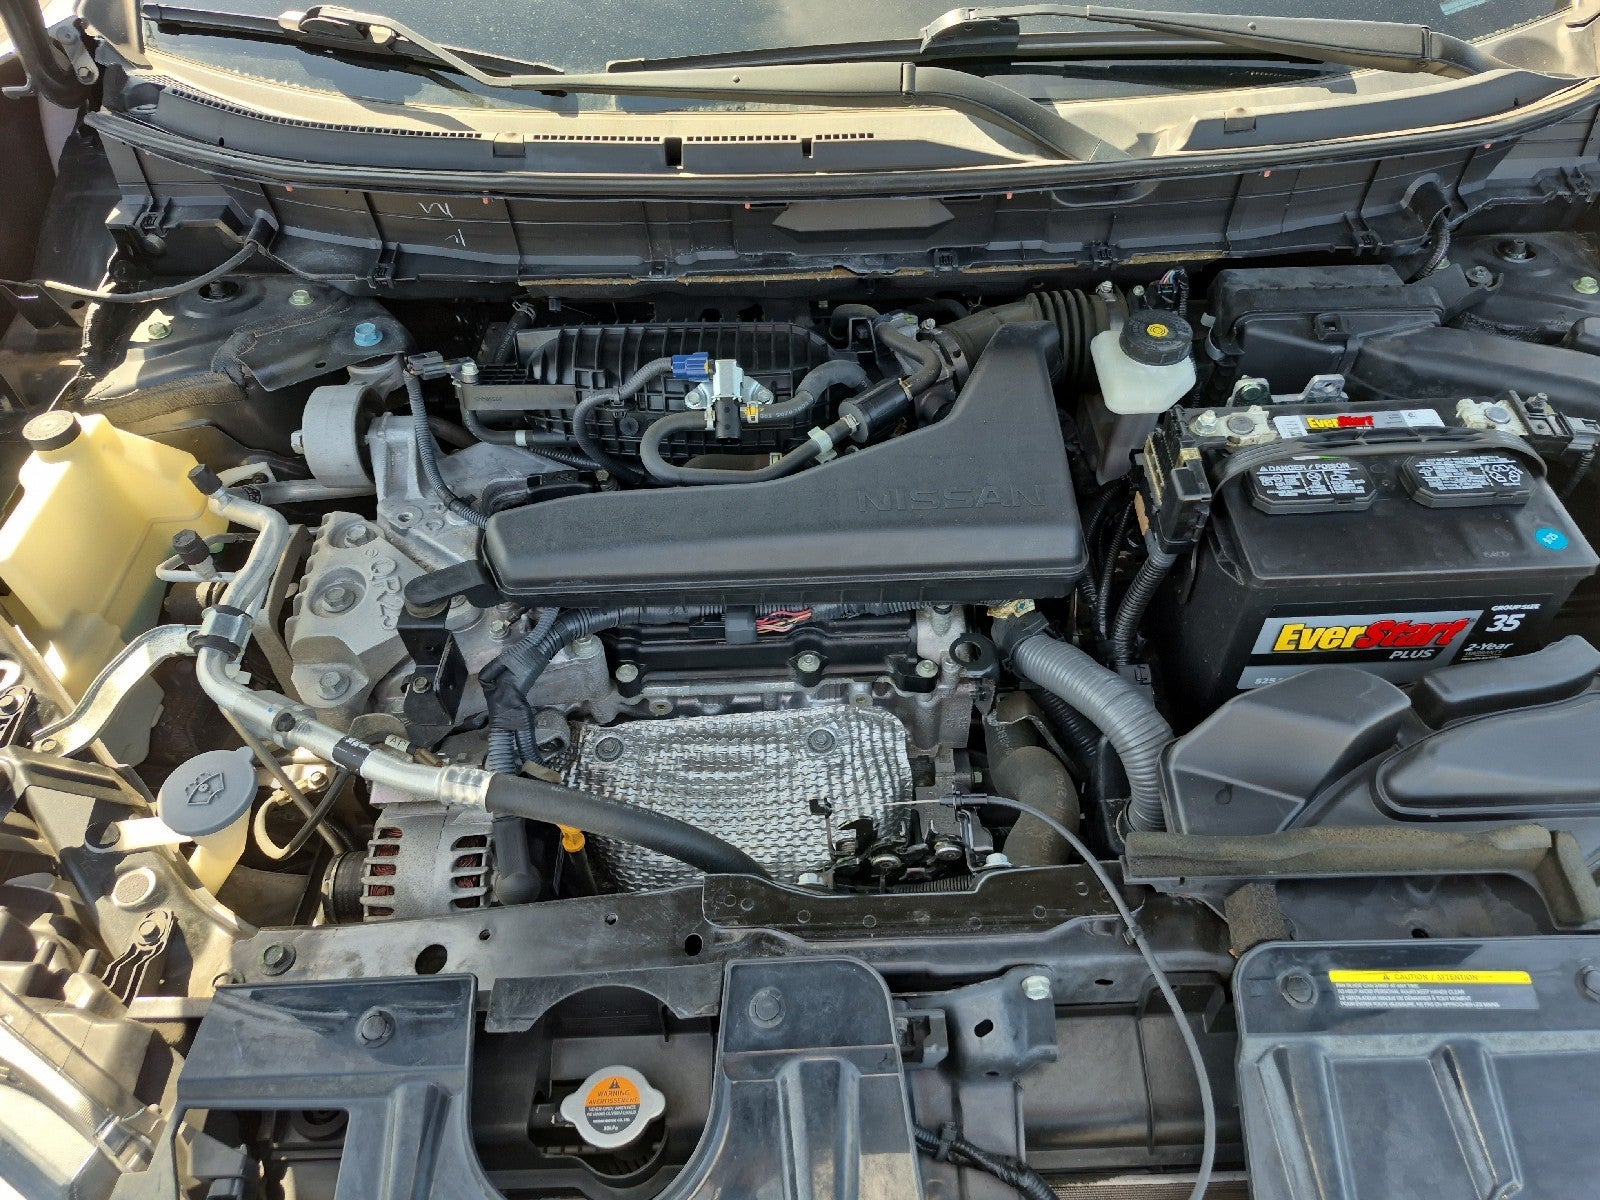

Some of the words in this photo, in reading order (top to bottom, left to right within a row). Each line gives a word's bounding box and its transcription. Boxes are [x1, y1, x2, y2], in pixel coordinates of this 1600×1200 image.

[1306, 415, 1375, 430] EverStart
[1268, 464, 1307, 472] DANGER
[1315, 462, 1350, 471] POISON
[857, 484, 1046, 513] NISSAN
[1491, 604, 1520, 612] GROUP
[1485, 613, 1526, 632] 35
[1273, 617, 1471, 652] EverStart
[1464, 642, 1514, 652] 2-Year
[1389, 649, 1434, 660] PLUS
[588, 1096, 638, 1105] AVERTISSEMENT
